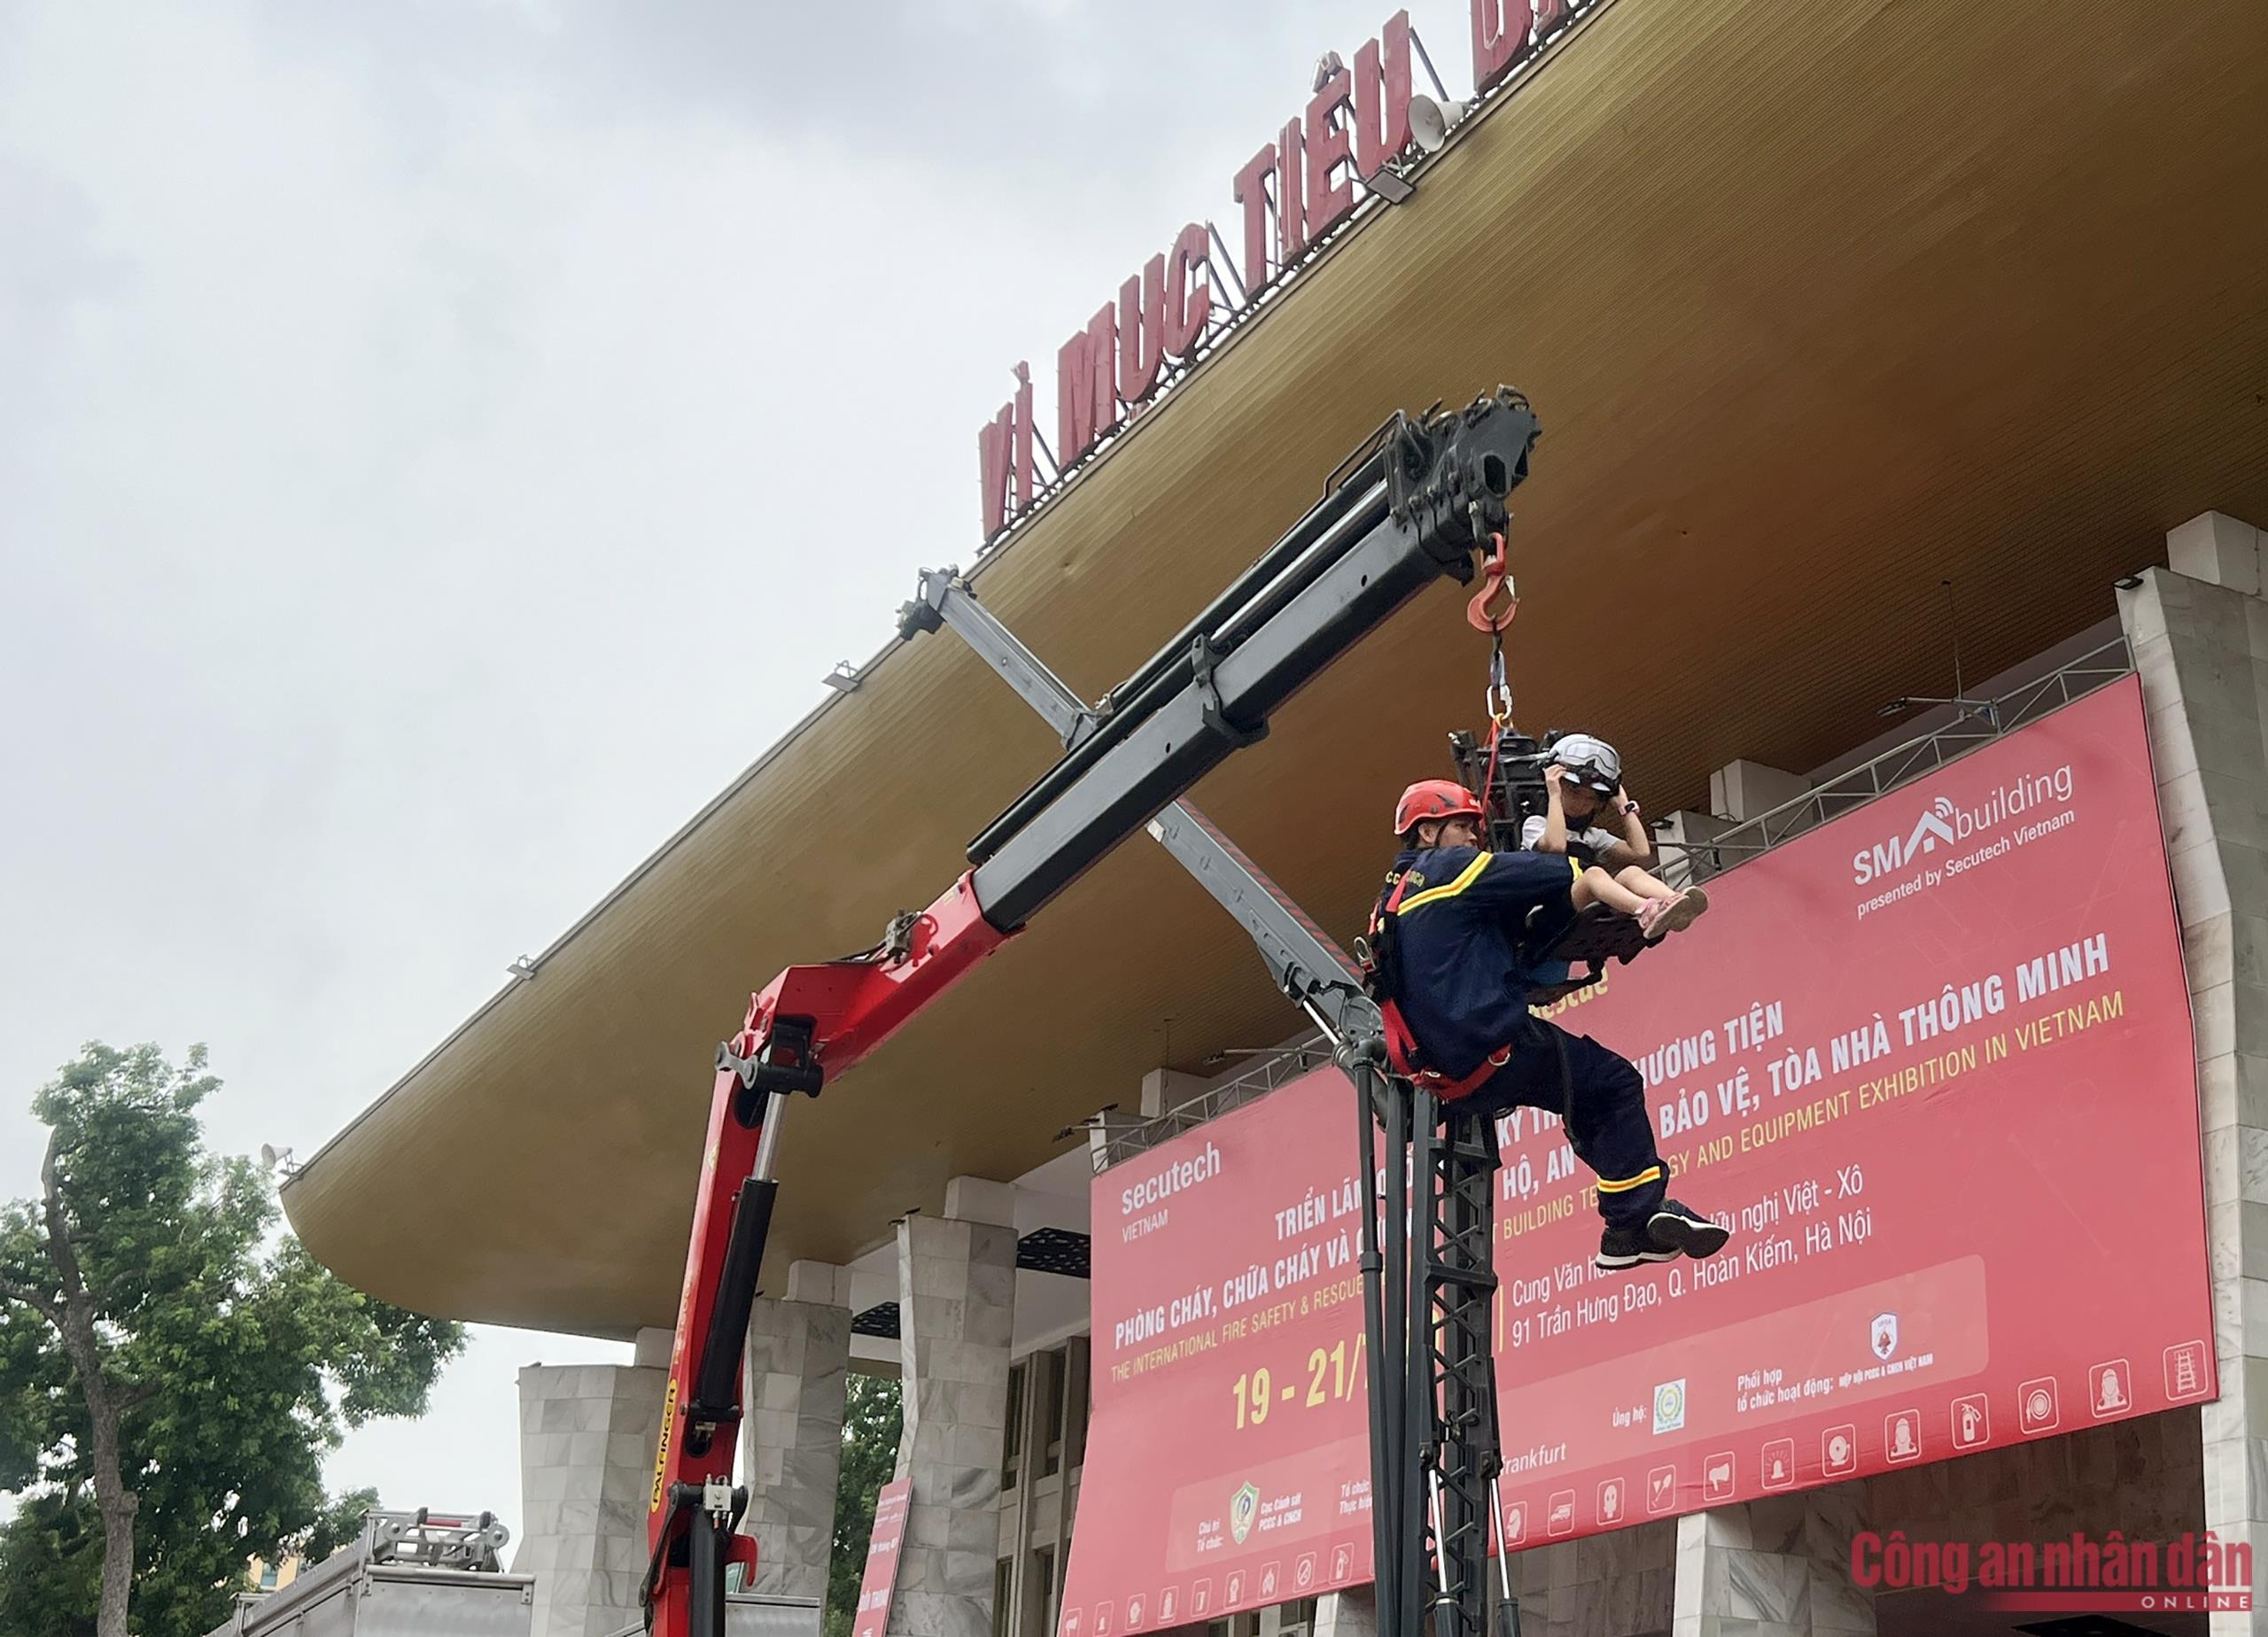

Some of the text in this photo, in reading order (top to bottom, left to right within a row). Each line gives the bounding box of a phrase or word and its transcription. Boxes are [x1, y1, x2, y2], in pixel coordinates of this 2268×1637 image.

[979, 9, 1413, 544] VÌ MỤC TIÊU
[1857, 810, 2075, 919] presented by Secutech Vietnam
[1112, 1361, 1130, 1383] THE
[1134, 1330, 1217, 1375] INTERNATIONAL
[1223, 1318, 1247, 1343] FIRE
[1251, 1301, 1295, 1333] SAFETY
[1301, 1296, 1309, 1315] &
[1503, 1195, 1573, 1240] BUILDING
[1697, 1136, 1733, 1168] AND
[1741, 1090, 1851, 1152] EQUIPMENT
[1859, 1045, 1976, 1109] EXHIBITION
[1984, 1033, 2008, 1063] IN
[2015, 990, 2124, 1051] VIETNAM
[1115, 1308, 1164, 1350] PHÒNG
[1170, 1284, 1217, 1328] CHÁY,
[1223, 1264, 1269, 1308] CHỮA
[1275, 1243, 1320, 1289] CHÁY
[1326, 1228, 1349, 1268] VÀ
[1503, 1153, 1539, 1201] HỘ,
[1547, 1143, 1574, 1183] AN
[1659, 1088, 1709, 1139] BẢO
[1717, 1066, 1760, 1117] VỆ,
[1767, 1047, 1822, 1097] TÒA
[1830, 1012, 1891, 1075] NHÀ
[1899, 974, 2005, 1046] THÔNG
[2016, 933, 2109, 1003] MINH
[1122, 1141, 1220, 1214] secutech
[1276, 1186, 1325, 1240] TRIỂN
[1631, 1030, 1716, 1089] HƯƠNG
[1723, 1000, 1783, 1054] TIỆN
[1122, 1209, 1169, 1243] VIETNAM
[1512, 1206, 1872, 1347] 91 Trần Hưng Đạo, Q. Hoàn Kiếm, Hà Nội
[1513, 1276, 1550, 1307] Cung
[1554, 1262, 1582, 1292] Văn
[1742, 1191, 1779, 1233] nghị
[1783, 1180, 1819, 1215] Việt
[1837, 1164, 1863, 1199] Xô
[1233, 1368, 1270, 1430] 19
[1282, 1385, 1294, 1400] -
